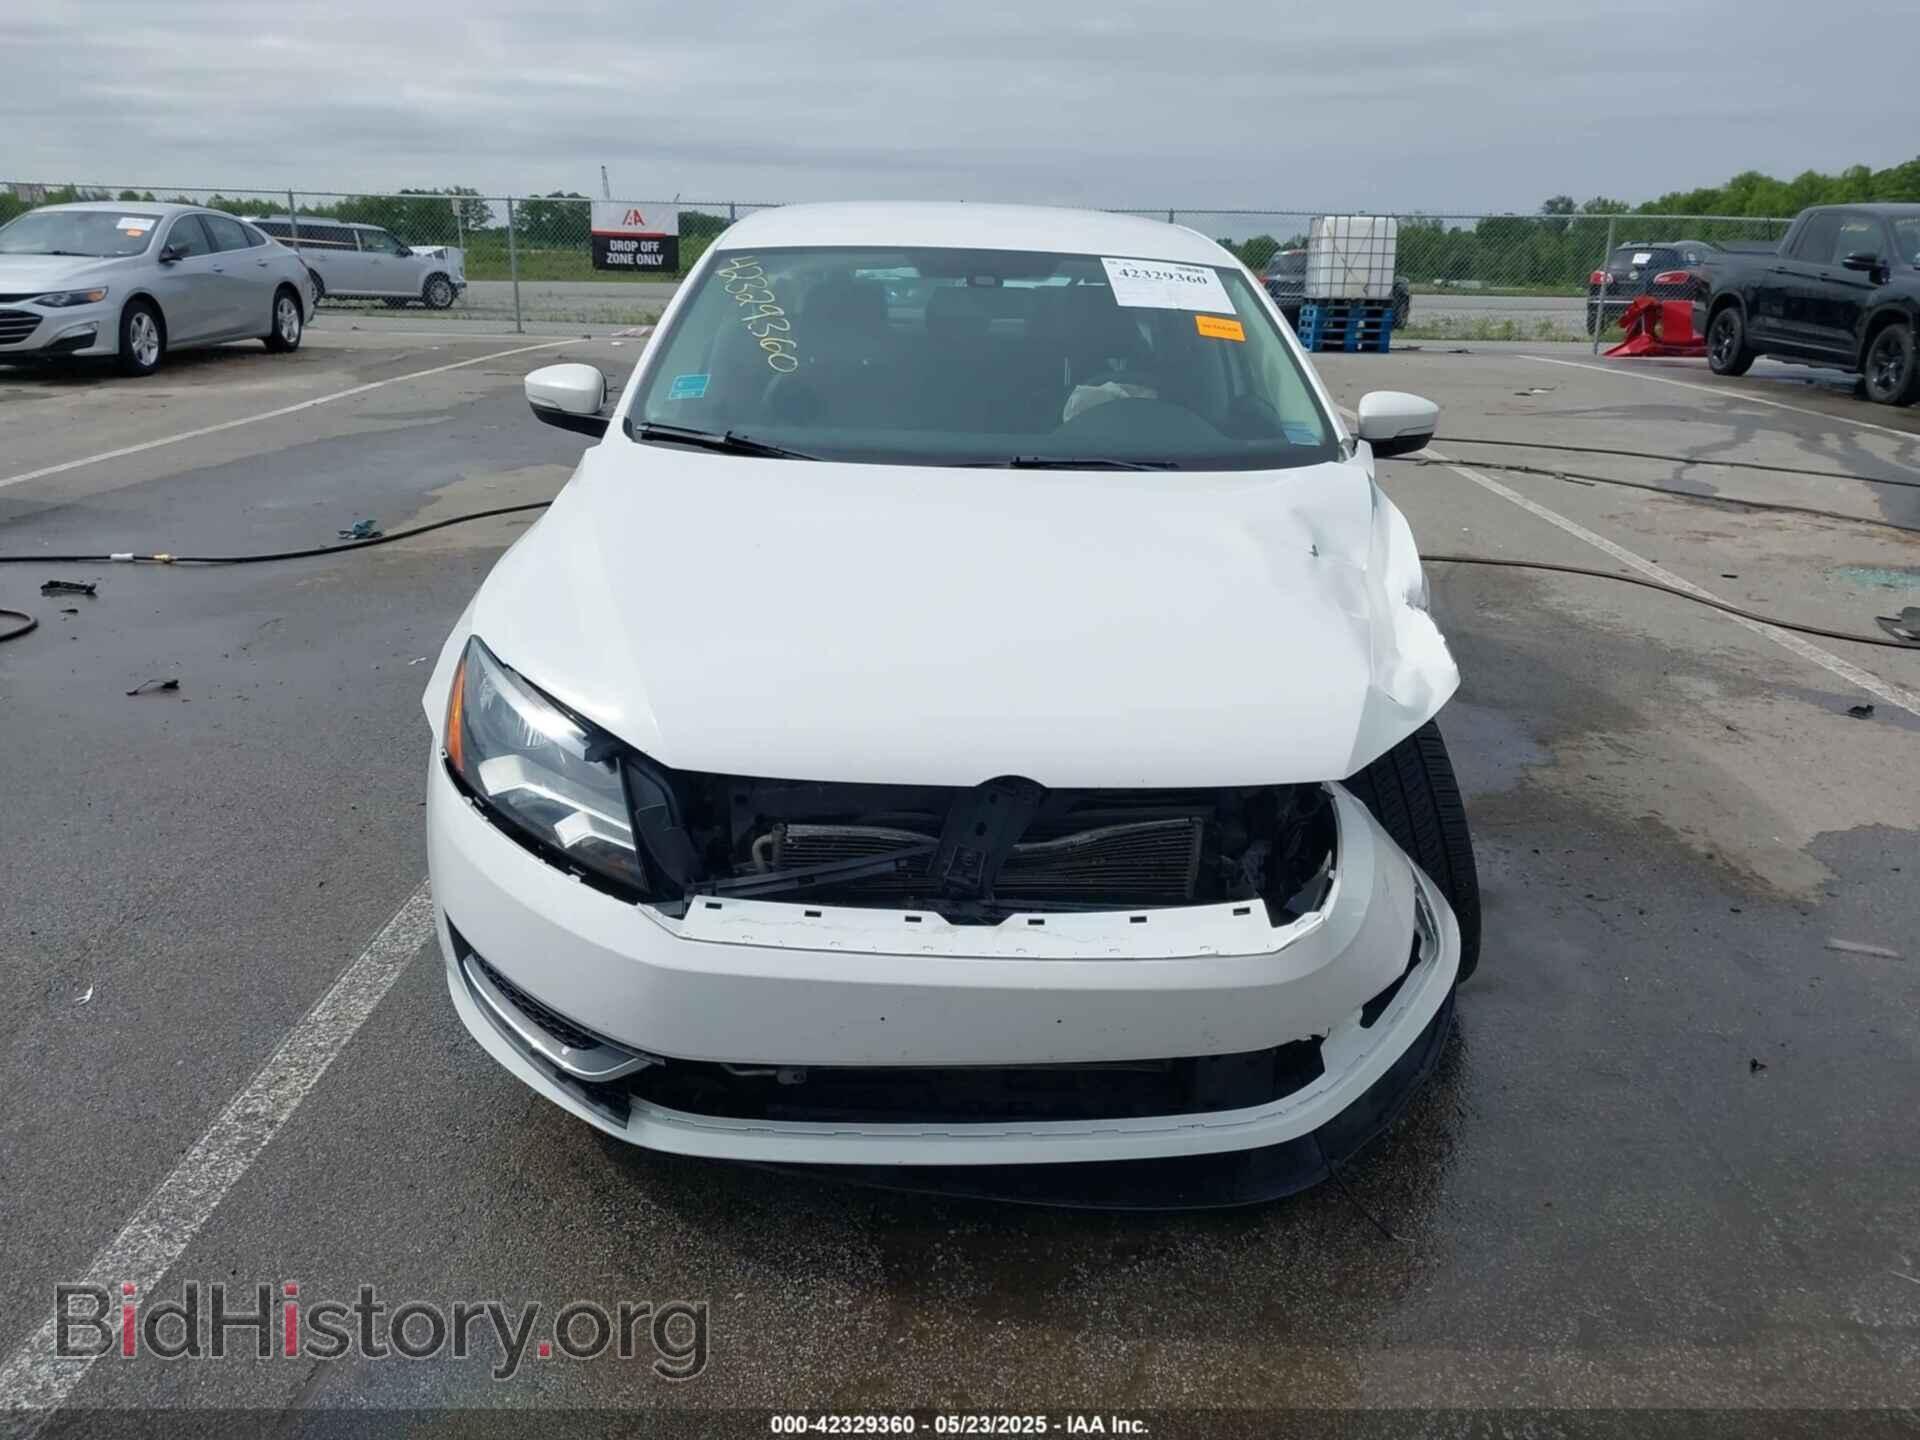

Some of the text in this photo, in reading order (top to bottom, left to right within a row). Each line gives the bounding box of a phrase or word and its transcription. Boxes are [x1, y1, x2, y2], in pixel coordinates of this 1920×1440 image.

[610, 240, 660, 253] DROP OFF
[606, 252, 664, 265] ZONE ONLY
[1119, 268, 1208, 285] 42329360
[715, 255, 798, 373] 42329360
